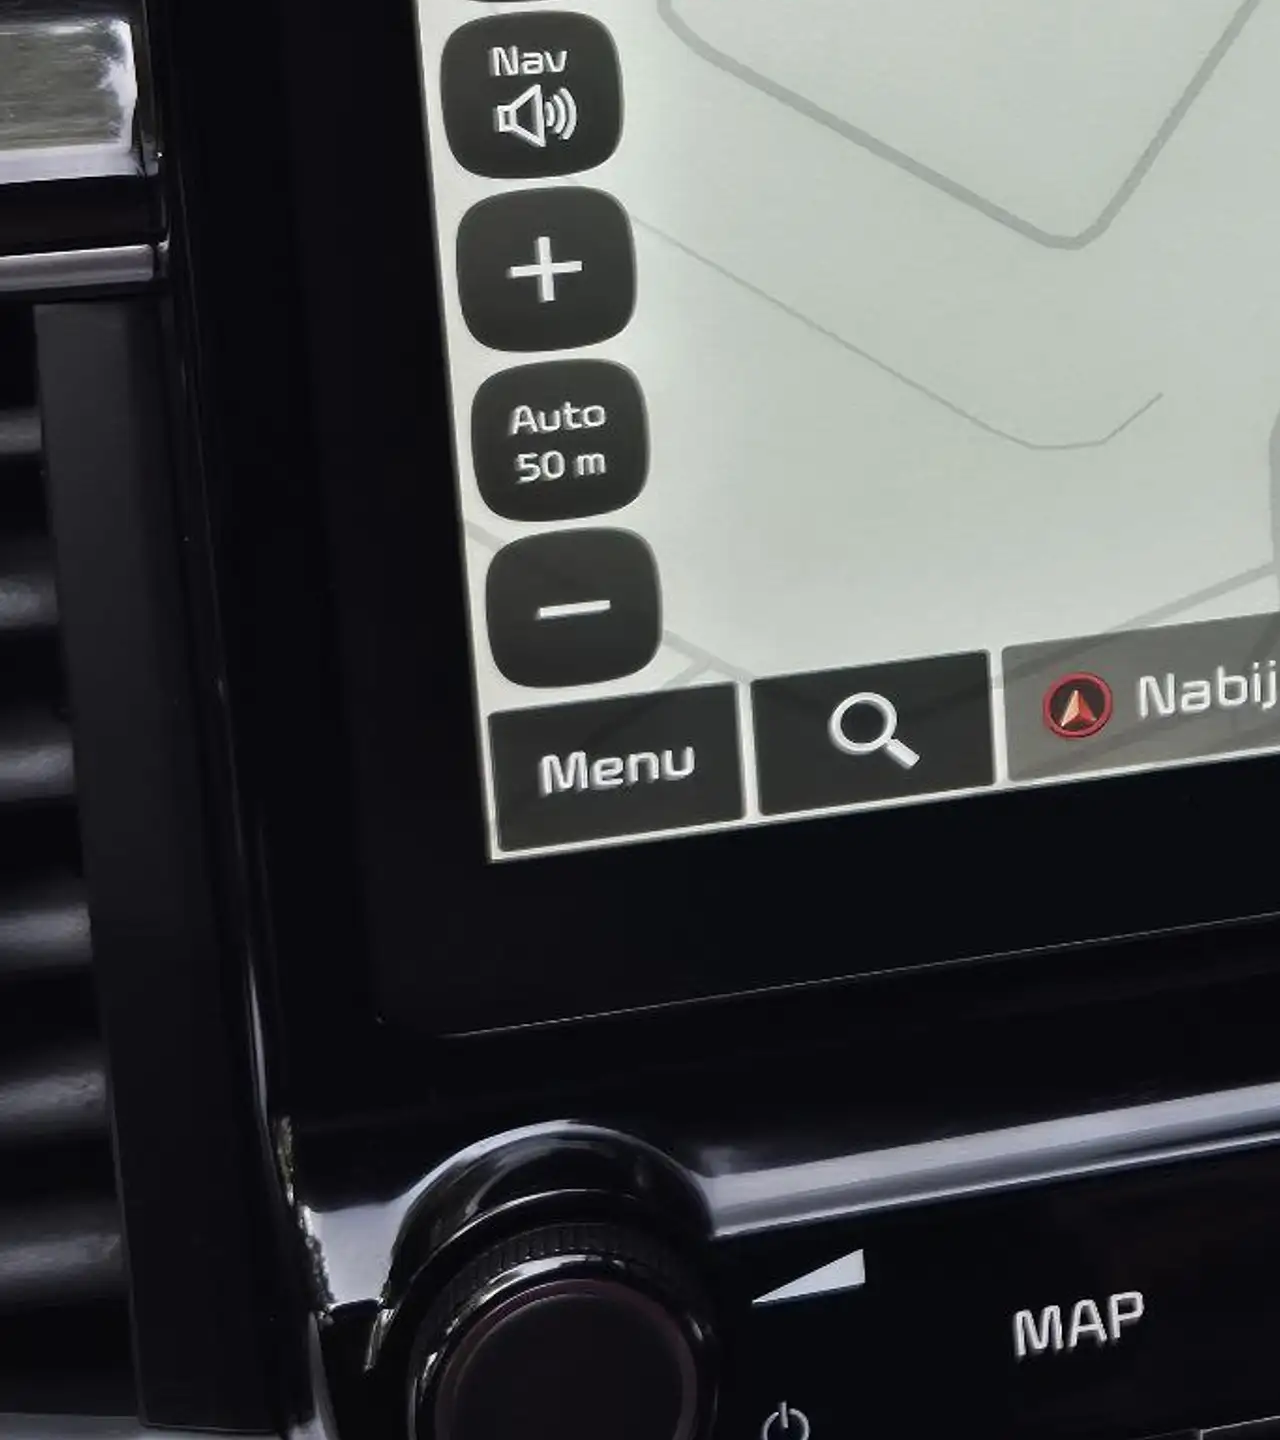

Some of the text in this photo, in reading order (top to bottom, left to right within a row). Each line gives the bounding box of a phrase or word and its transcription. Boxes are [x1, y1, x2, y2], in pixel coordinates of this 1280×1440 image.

[489, 46, 568, 77] Nav
[509, 401, 607, 437] Auto
[516, 450, 607, 484] 50 m
[1137, 659, 1278, 720] Nabij
[537, 746, 696, 797] Menu
[1013, 1291, 1146, 1358] MAP
